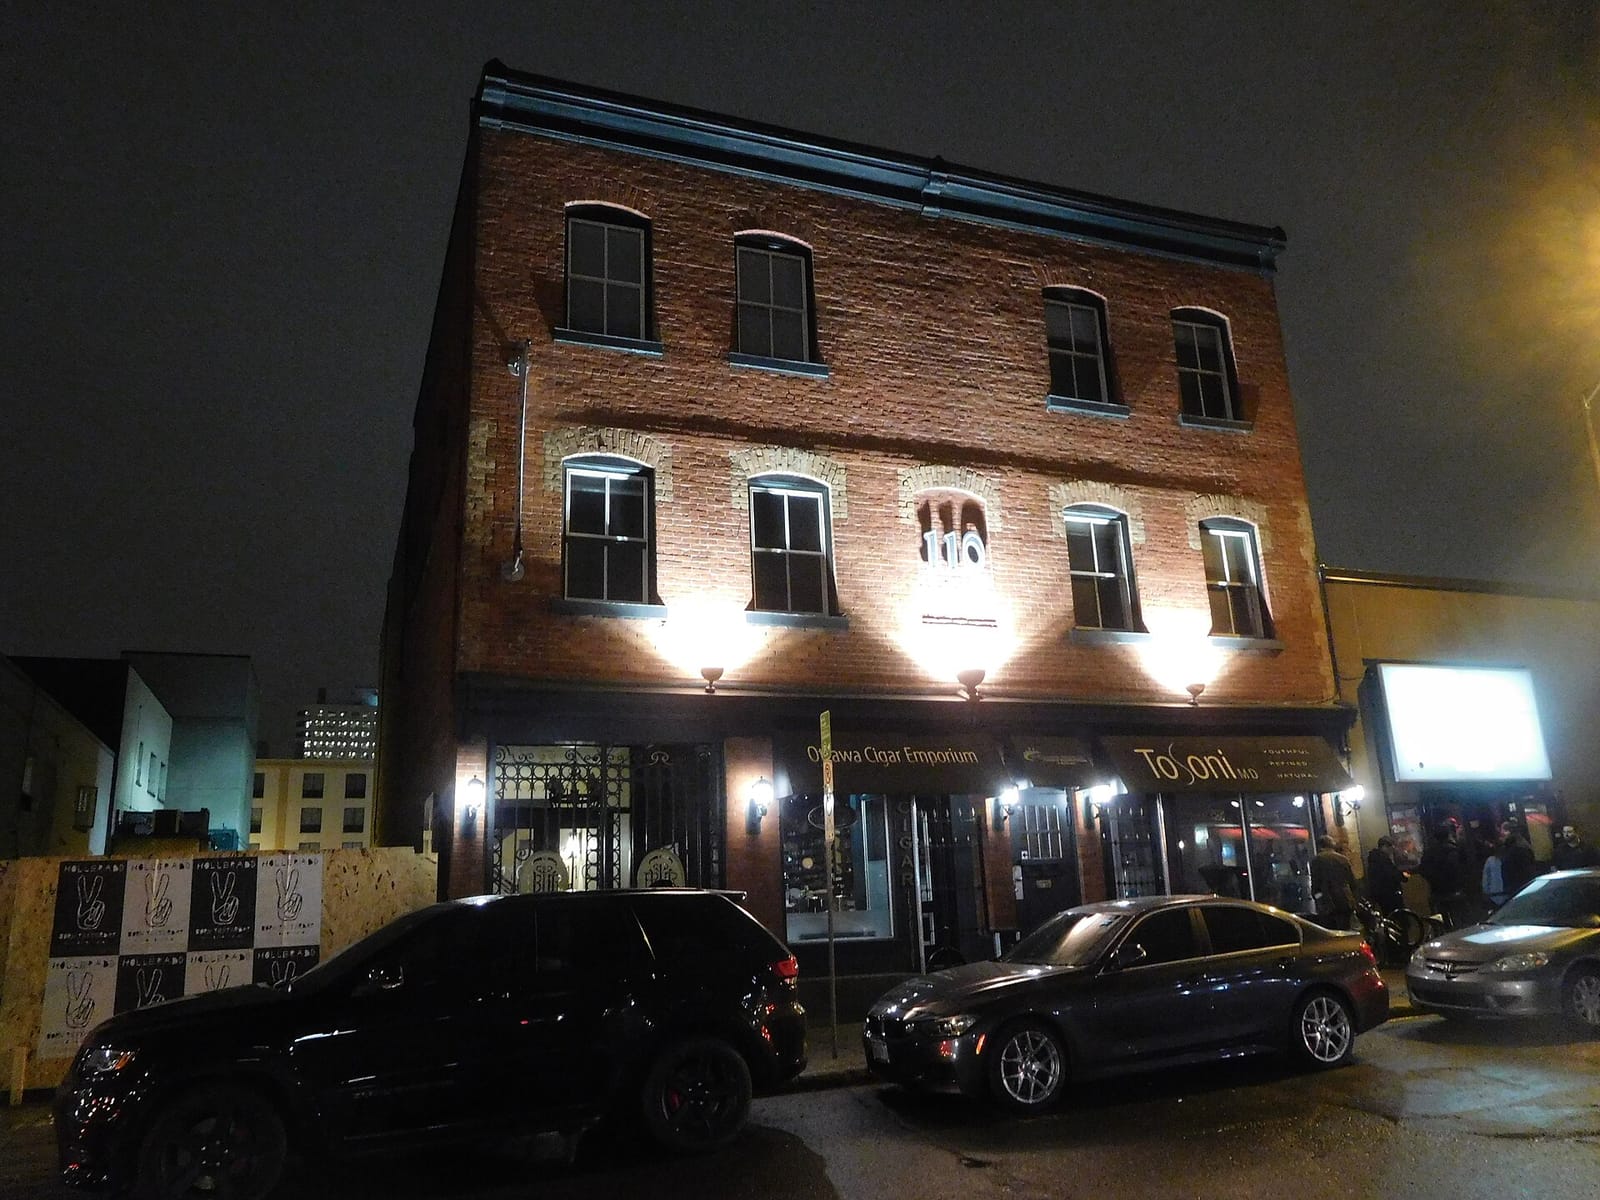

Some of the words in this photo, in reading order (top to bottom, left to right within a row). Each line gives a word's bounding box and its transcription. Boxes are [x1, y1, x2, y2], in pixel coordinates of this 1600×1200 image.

[924, 528, 986, 570] 110
[864, 746, 901, 767] Cigar
[903, 746, 979, 767] Emporium
